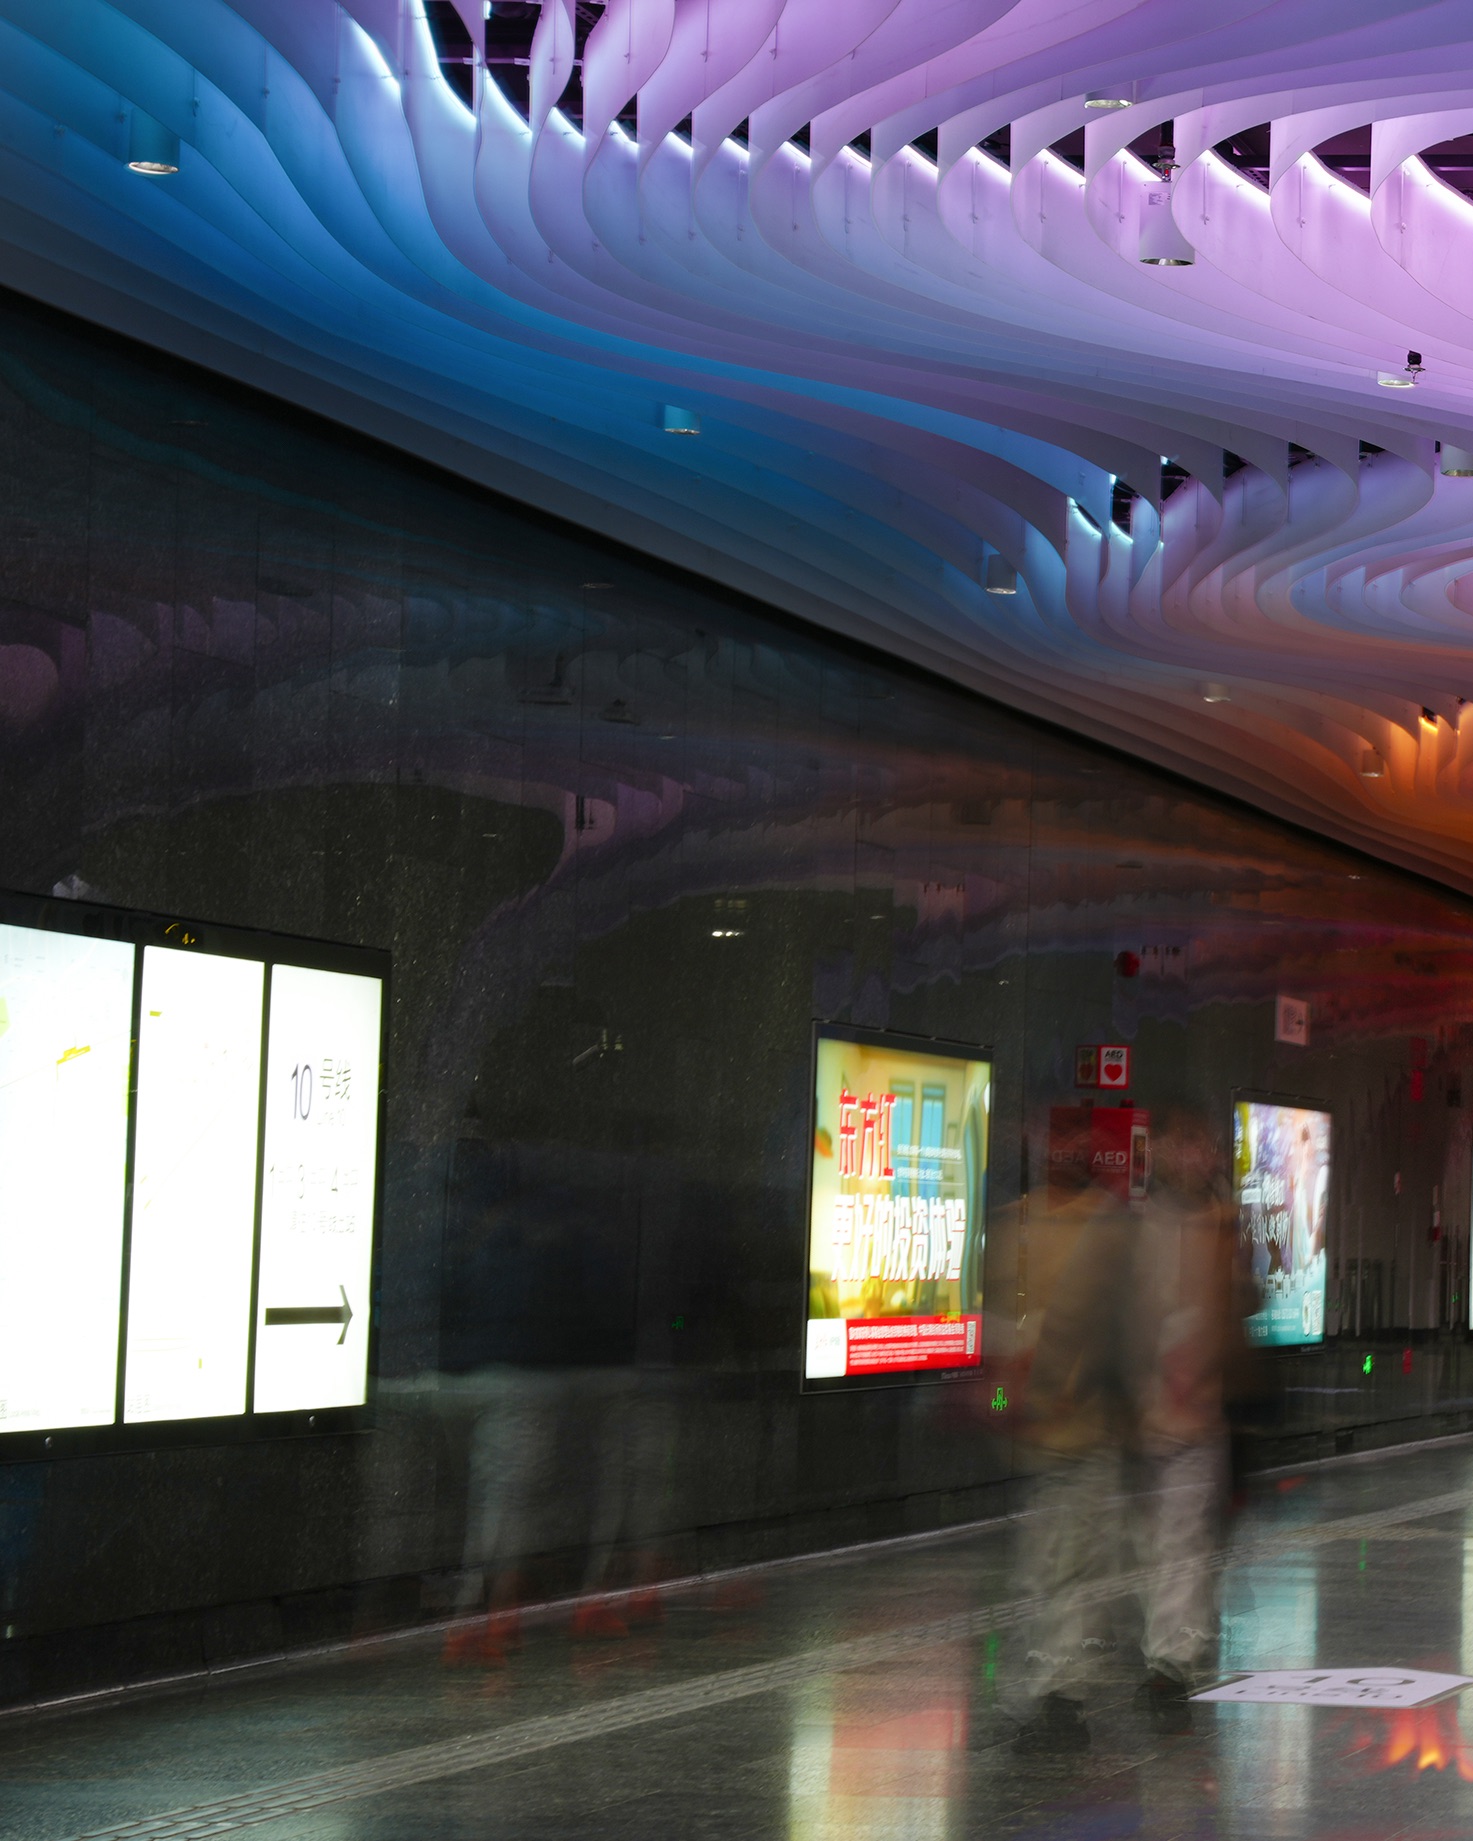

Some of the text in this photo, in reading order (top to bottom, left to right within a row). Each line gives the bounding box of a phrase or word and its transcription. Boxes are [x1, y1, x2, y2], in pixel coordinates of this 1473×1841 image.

[1104, 1050, 1123, 1059] AED
[290, 1062, 313, 1121] 10
[319, 1057, 352, 1100] 号线
[839, 1088, 897, 1180] 东方红
[1092, 1151, 1128, 1165] AED
[831, 1194, 967, 1283] 更好的投资体验
[1289, 1675, 1416, 1687] 10
